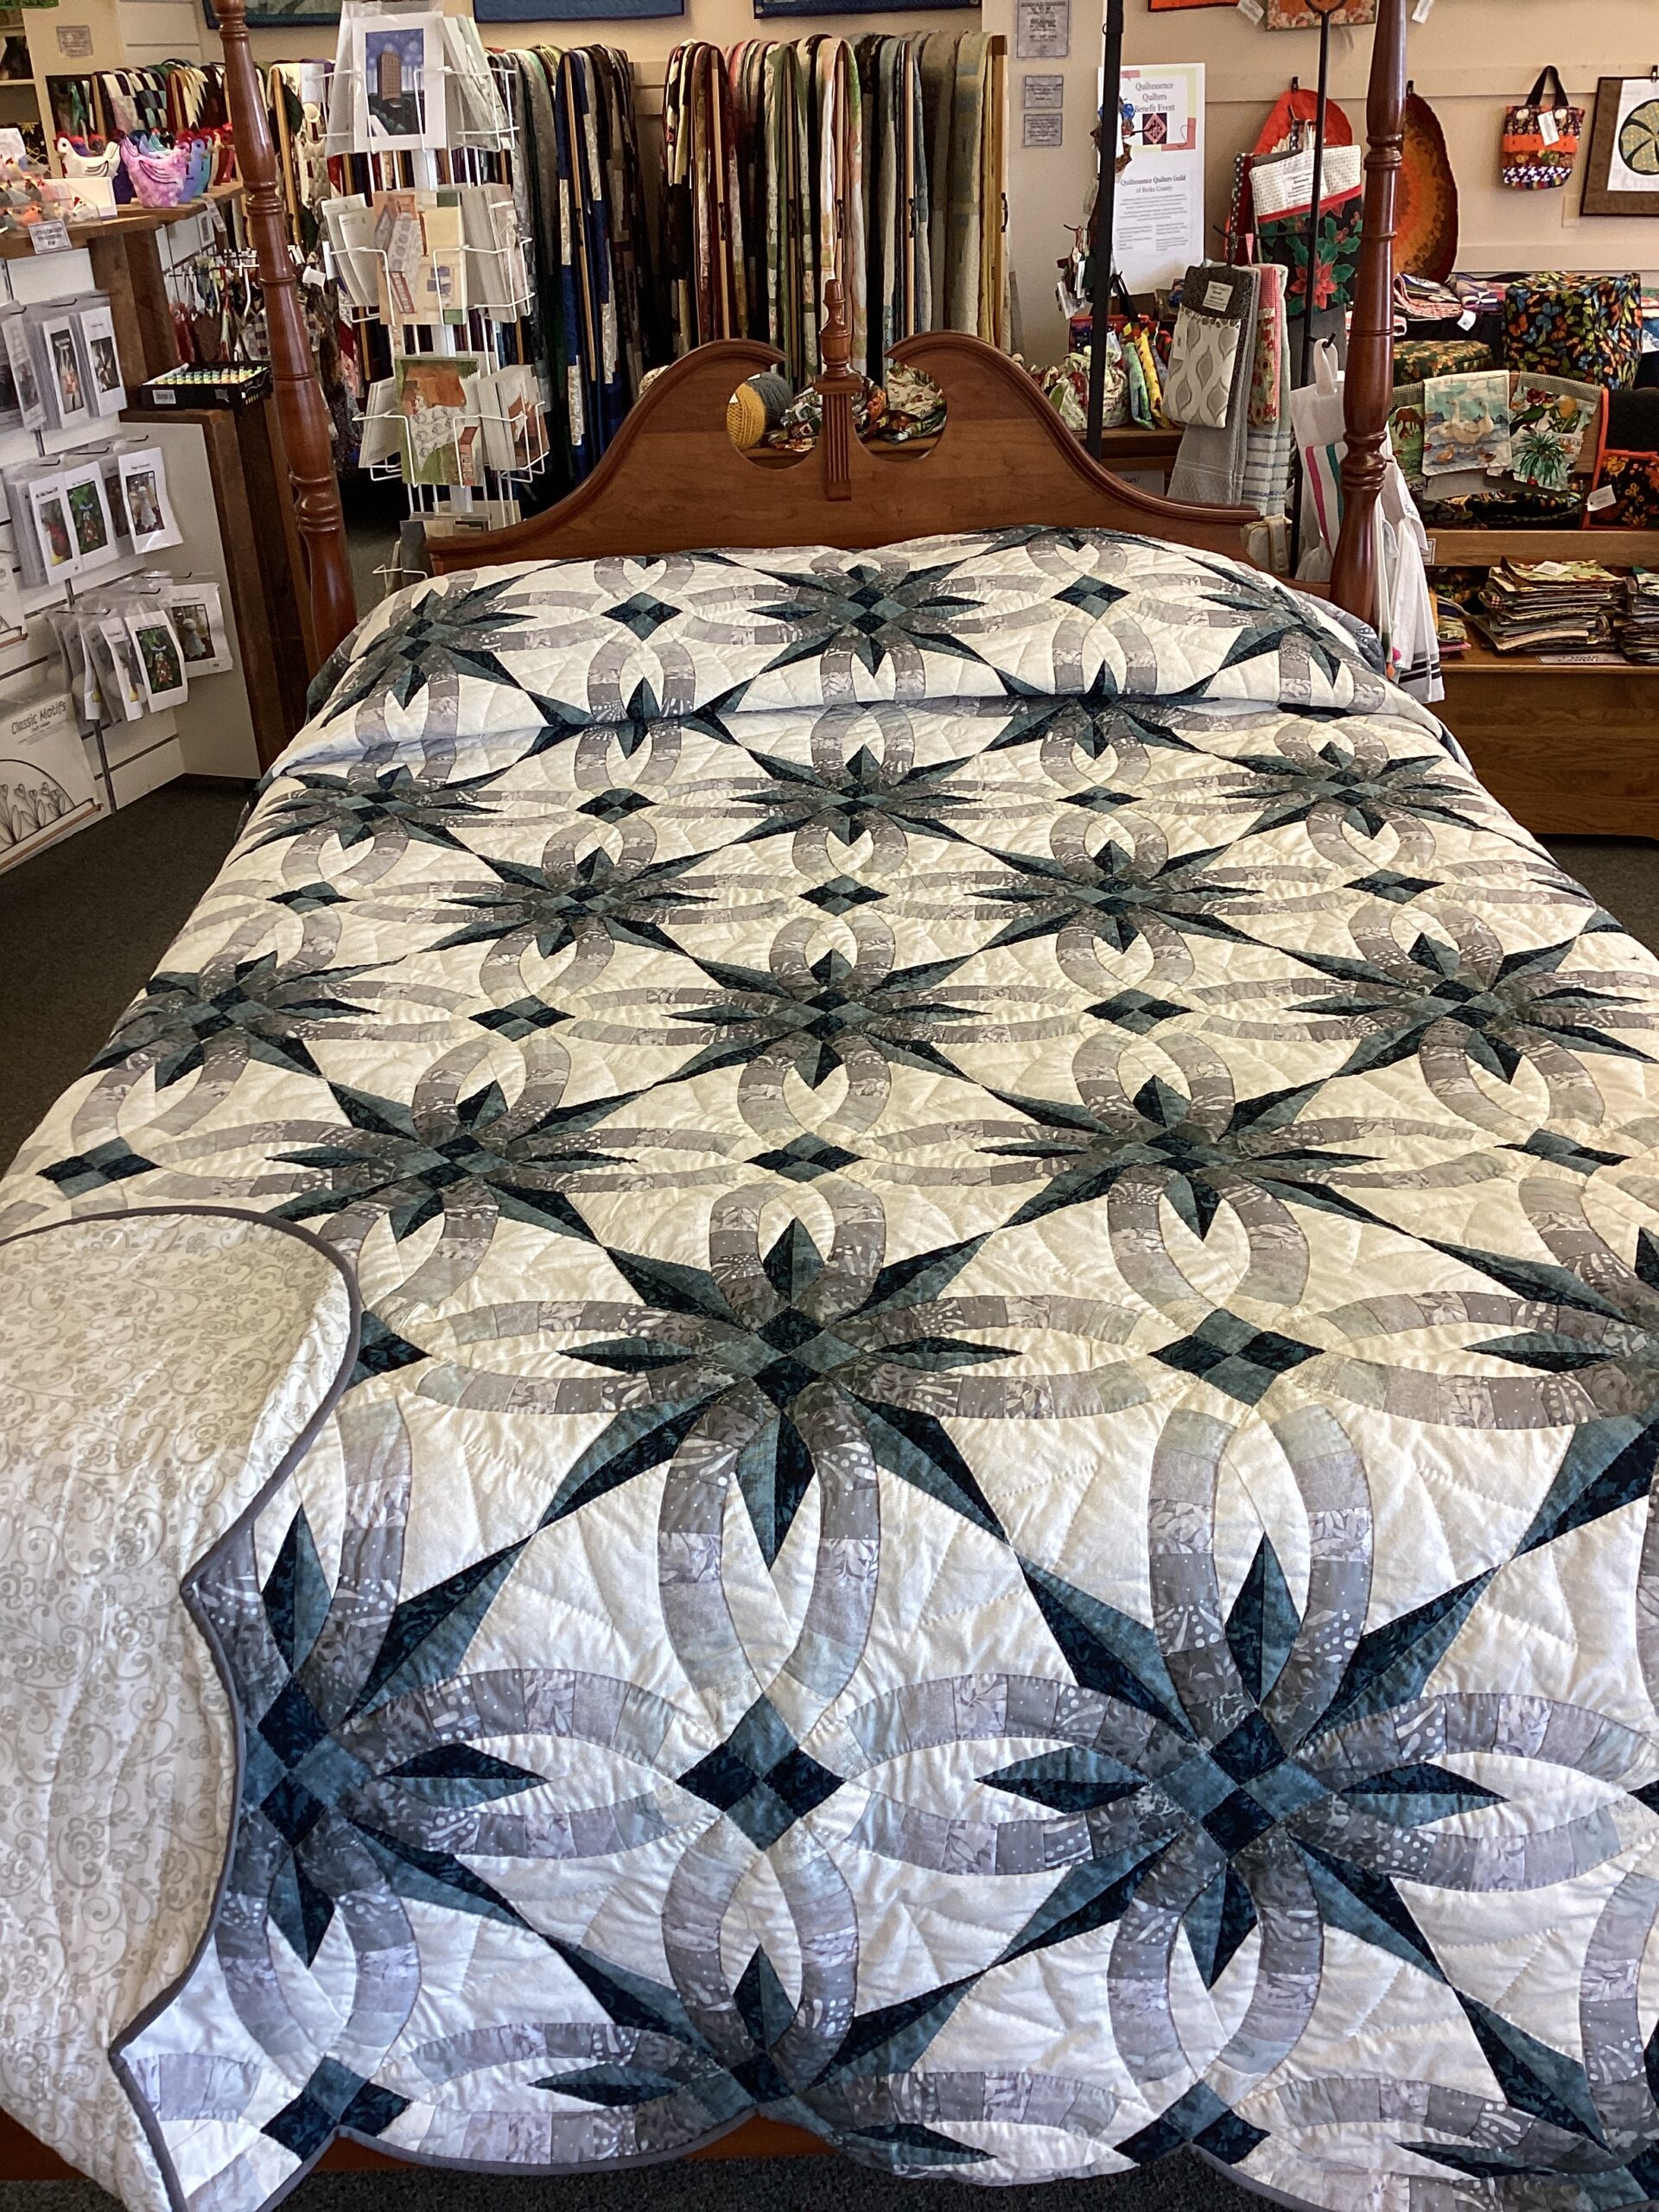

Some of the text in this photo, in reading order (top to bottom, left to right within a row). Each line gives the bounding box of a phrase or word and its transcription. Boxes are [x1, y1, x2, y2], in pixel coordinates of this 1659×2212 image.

[1135, 82, 1173, 91] Quiltessence
[1142, 93, 1166, 102] Quilters
[11, 714, 38, 734] Classic
[40, 701, 67, 721] Motifs
